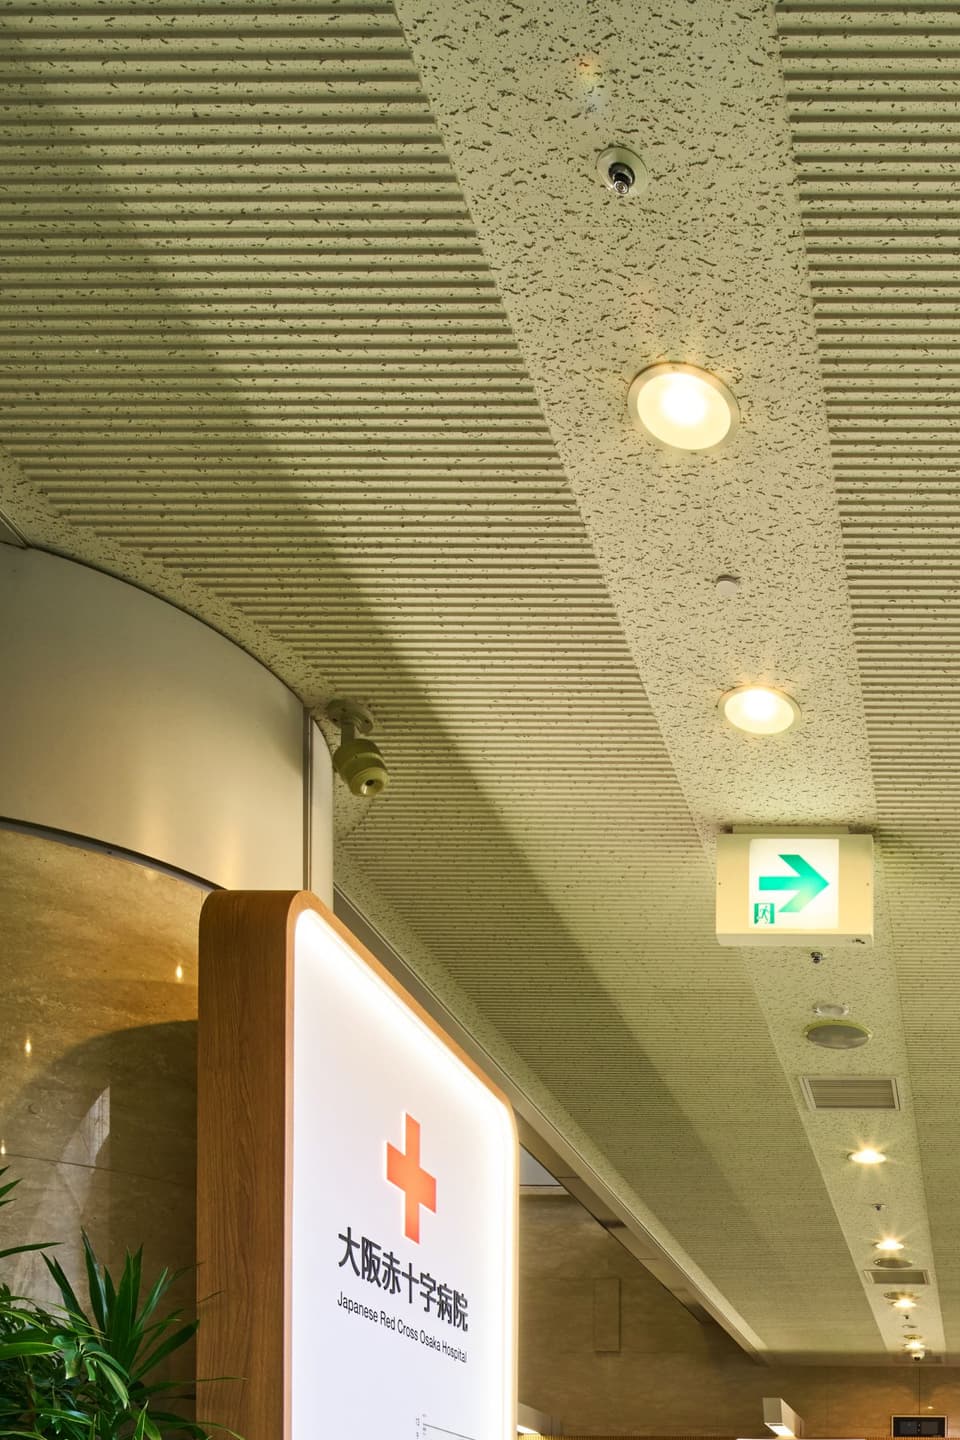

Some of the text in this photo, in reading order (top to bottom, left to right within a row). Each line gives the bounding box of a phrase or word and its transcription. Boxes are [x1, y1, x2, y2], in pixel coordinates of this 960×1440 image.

[338, 1226, 468, 1332] 大阪赤十字病院
[337, 1291, 467, 1363] Japanese Red Cross Osaka Hospital
